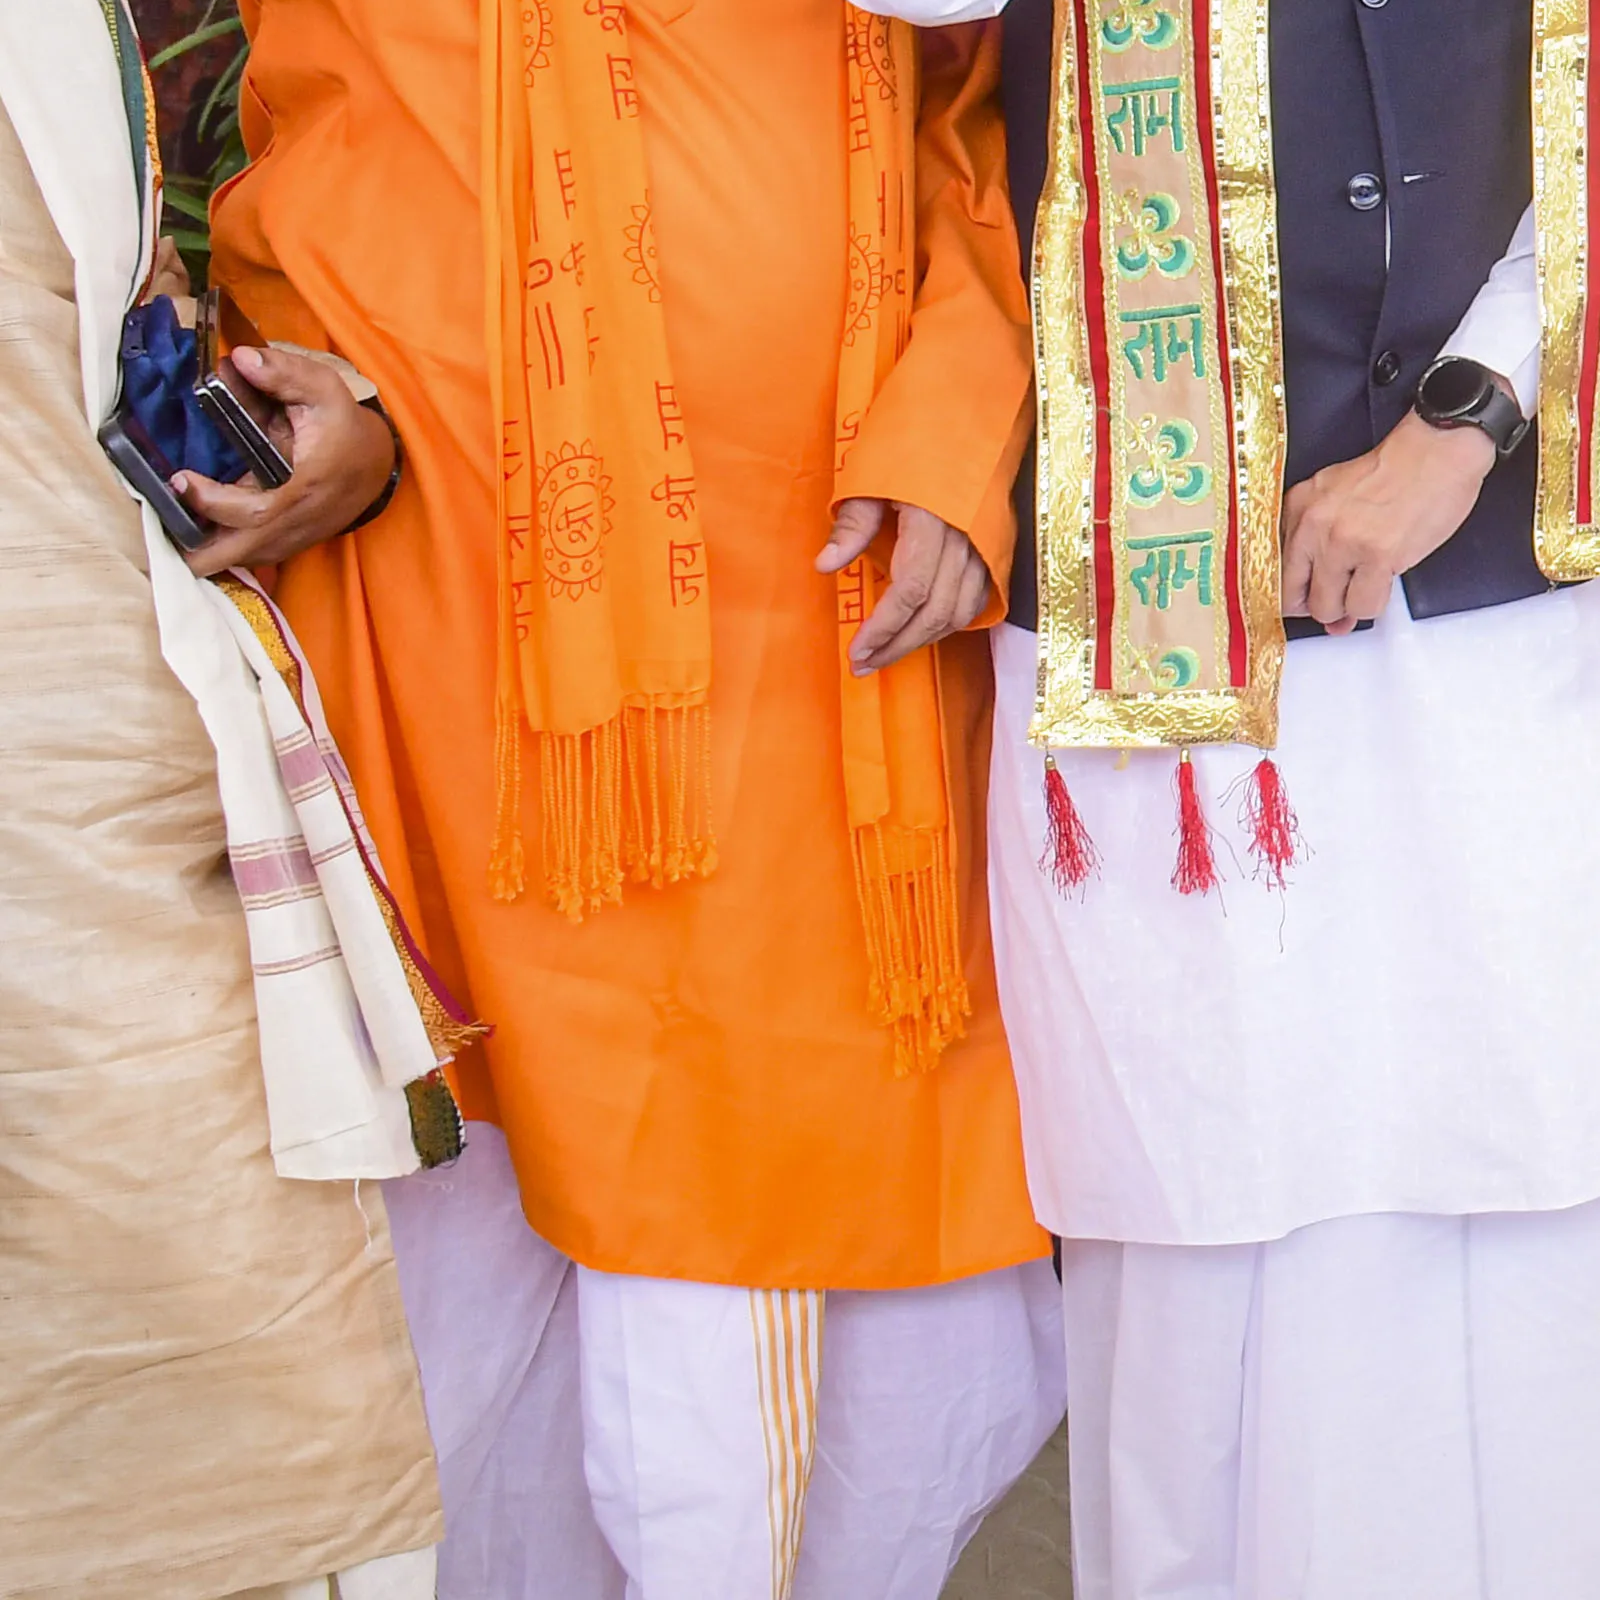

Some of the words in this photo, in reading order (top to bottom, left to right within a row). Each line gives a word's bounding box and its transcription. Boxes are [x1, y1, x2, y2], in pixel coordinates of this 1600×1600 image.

[605, 53, 640, 121] जय
[1102, 76, 1185, 157] राम
[1118, 303, 1207, 383] राम
[655, 380, 686, 451] राम
[650, 473, 697, 523] श्री
[669, 540, 705, 608] जय
[1124, 530, 1215, 610] राम
